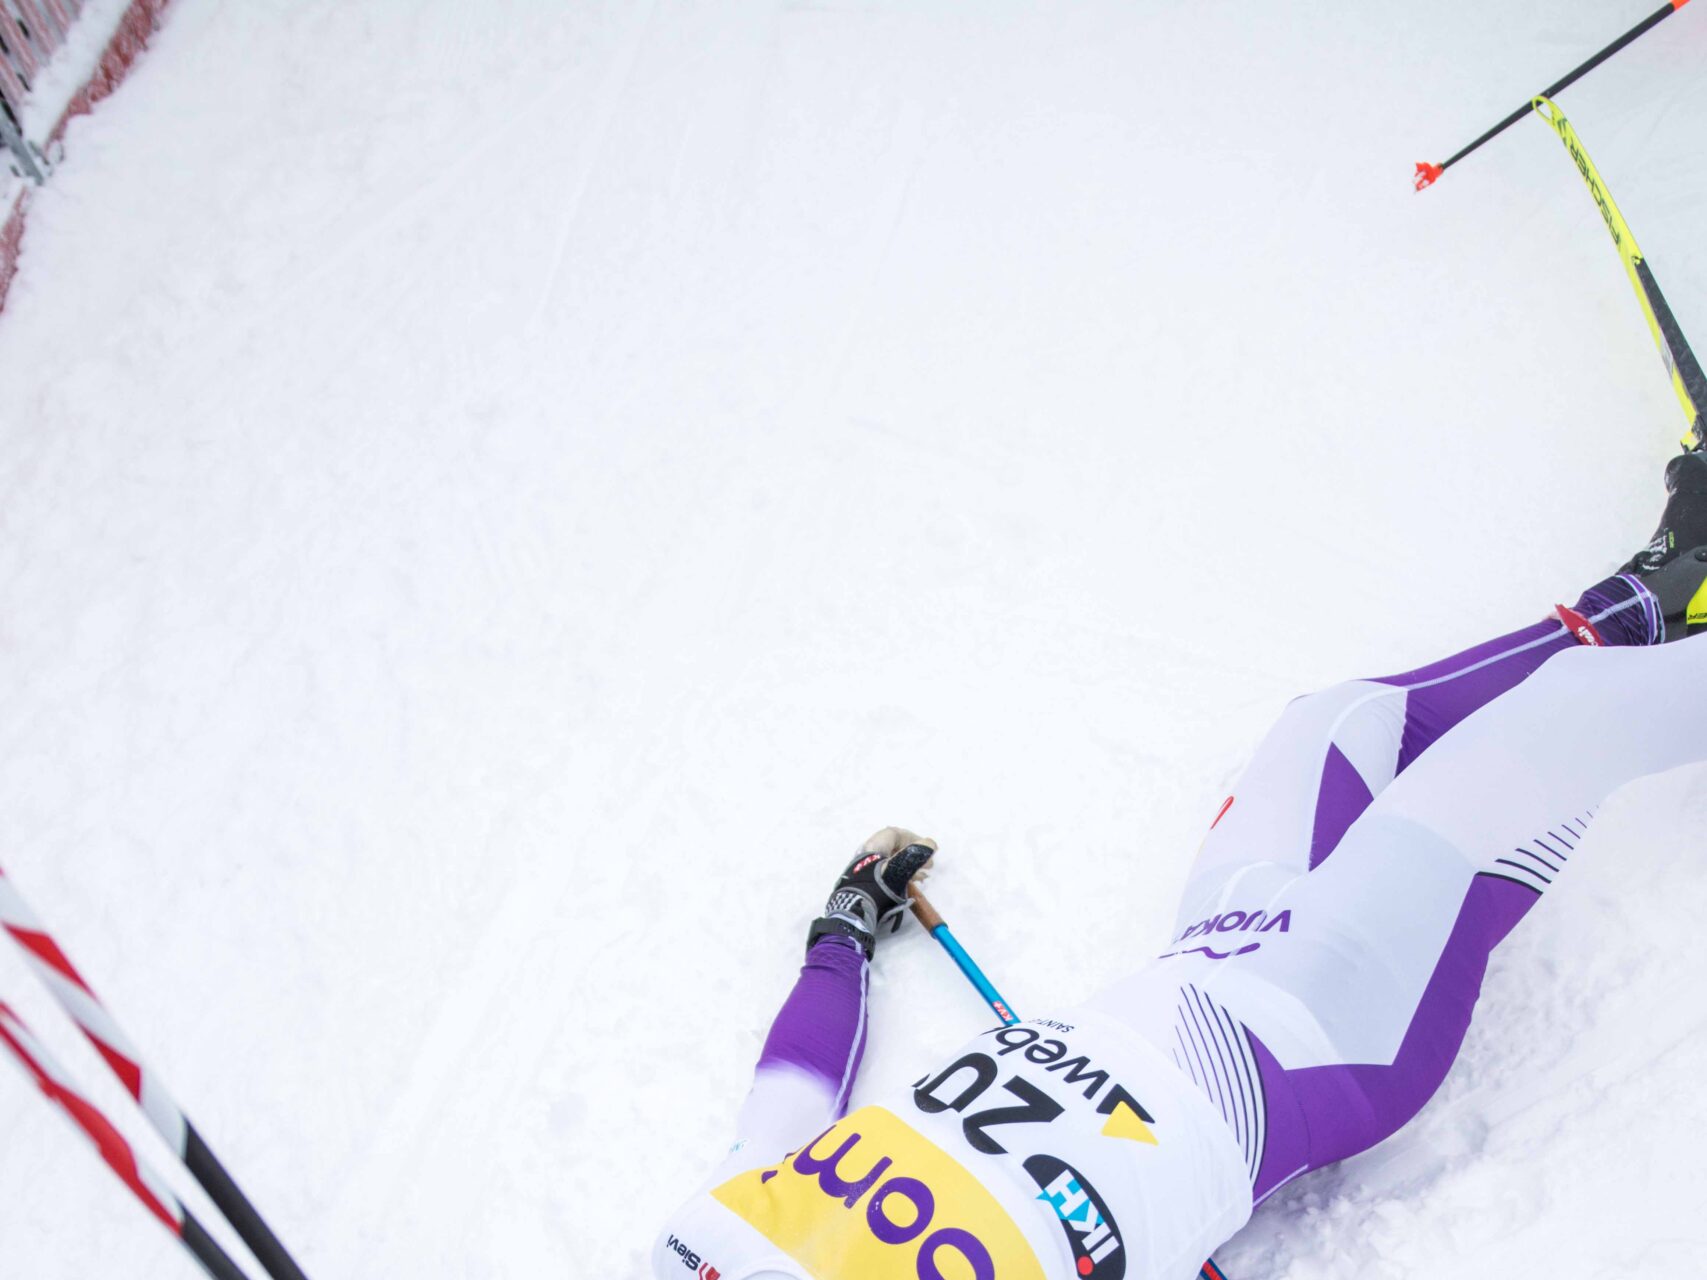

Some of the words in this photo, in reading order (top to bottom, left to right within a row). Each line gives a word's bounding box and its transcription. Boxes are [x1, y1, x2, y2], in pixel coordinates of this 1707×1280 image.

[1570, 142, 1621, 247] FISCHER
[1173, 909, 1292, 944] VUOKA
[1034, 1018, 1075, 1033] SAINT
[978, 1024, 1110, 1100] web
[912, 1053, 1066, 1155] 20
[666, 1234, 701, 1271] Sievi
